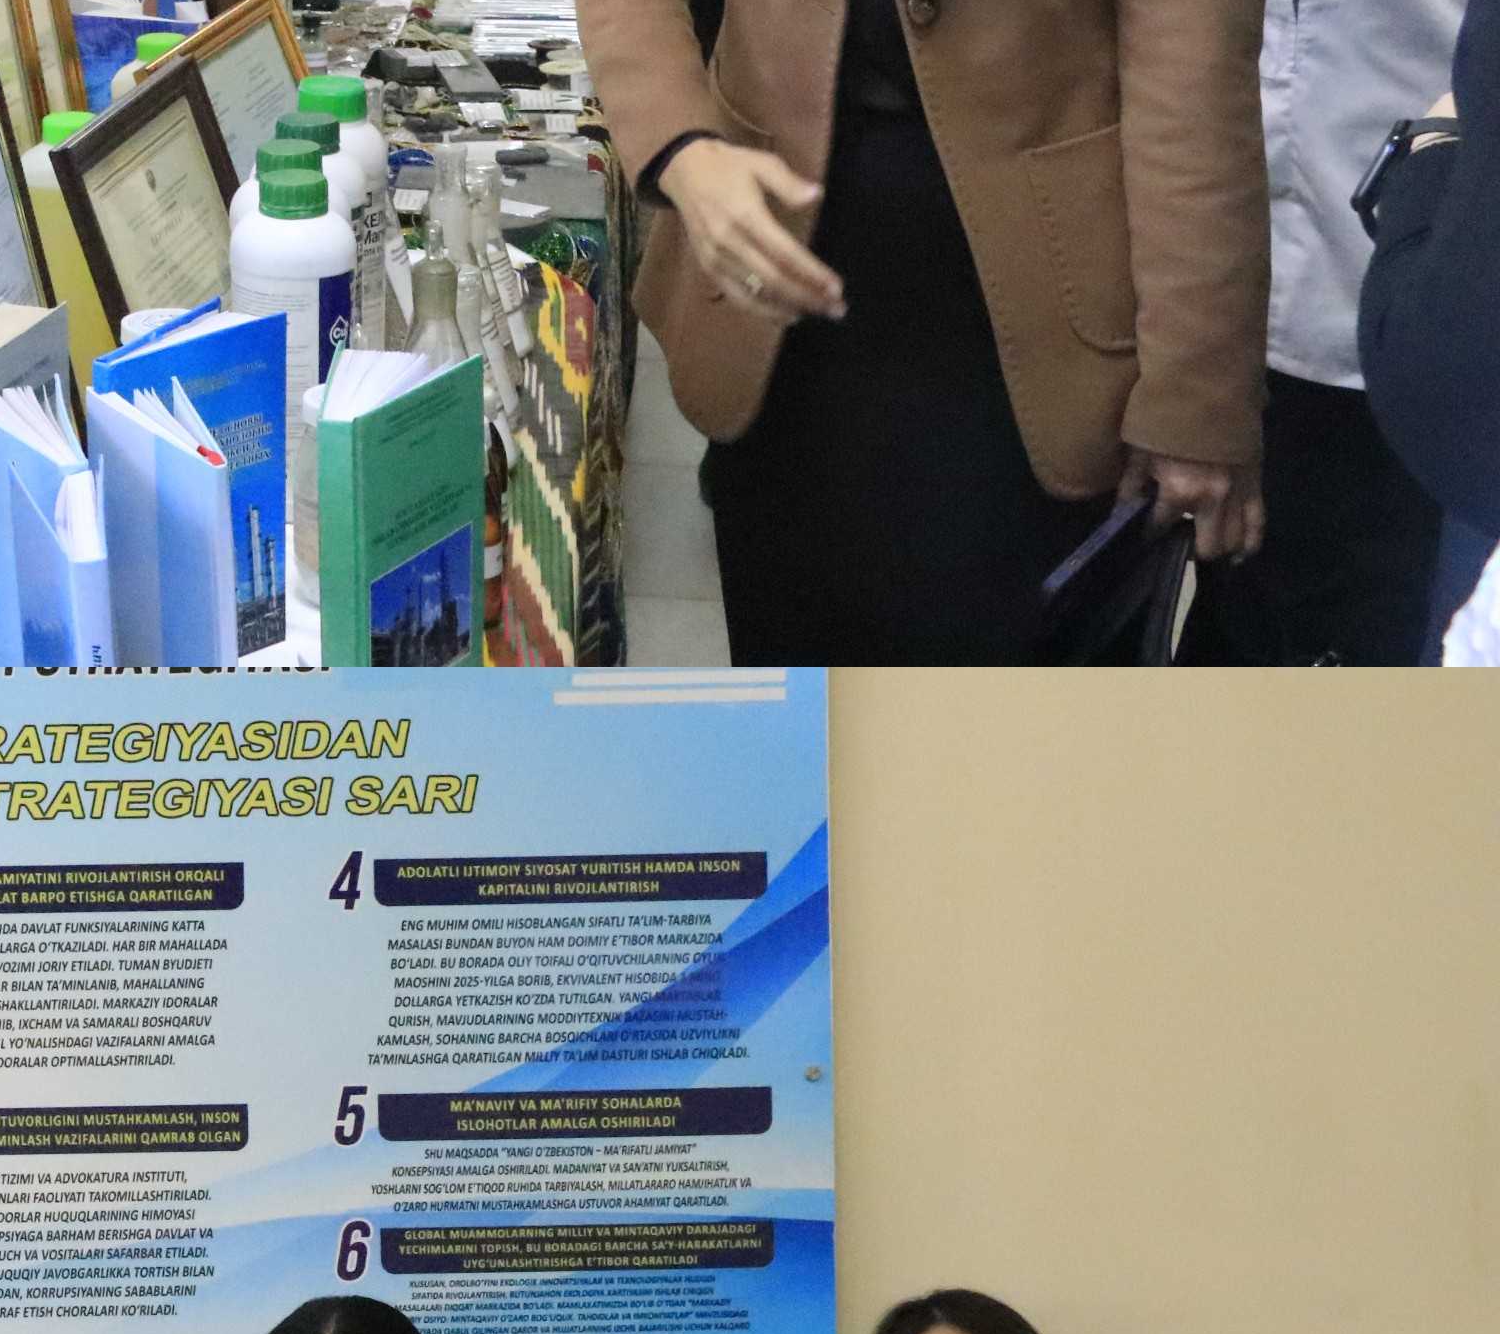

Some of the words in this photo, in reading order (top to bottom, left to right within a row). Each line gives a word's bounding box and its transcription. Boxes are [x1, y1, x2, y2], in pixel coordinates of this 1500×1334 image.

[344, 774, 480, 816] SARI
[397, 866, 459, 878] ADOLATLI
[525, 864, 577, 875] SIYOSAT
[581, 863, 640, 874] YURITISH
[645, 862, 694, 873] HAMDA
[699, 860, 740, 872] INSON
[66, 871, 170, 883] RIVOJLANTIRISH
[175, 870, 224, 882] ORQALI
[329, 851, 362, 909] 4
[479, 884, 549, 895] KAPITALINI
[555, 881, 659, 894] RIVOJLANTIRISH
[22, 892, 65, 903] BARPO
[70, 891, 125, 902] ETISHGA
[130, 890, 212, 902] QARATILGAN
[21, 923, 62, 934] DAVLAT
[65, 921, 168, 933] FUNKSIYALARINING
[172, 921, 204, 931] KATTA
